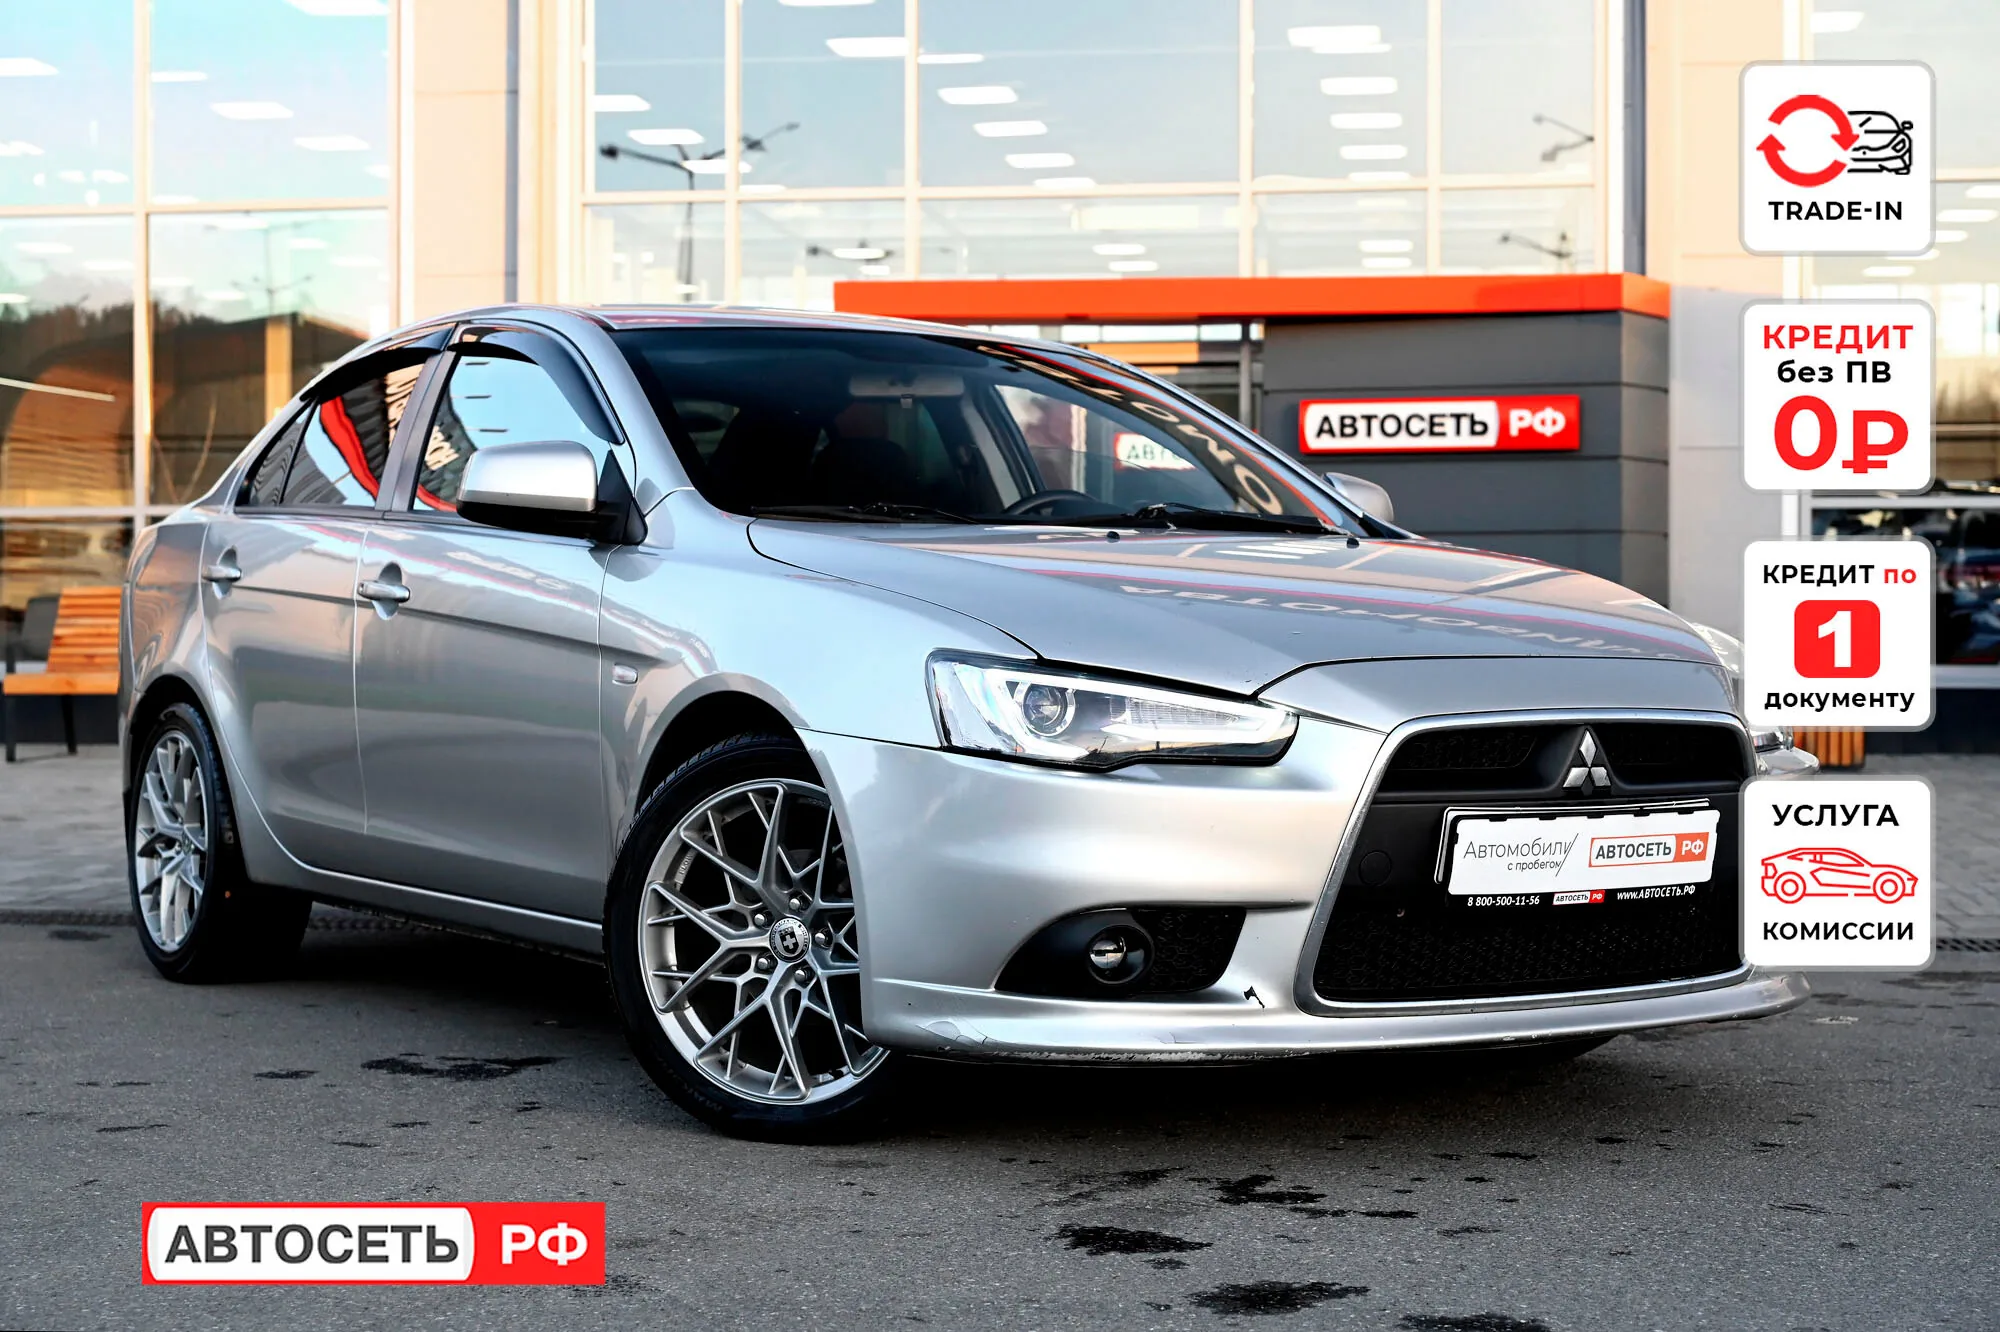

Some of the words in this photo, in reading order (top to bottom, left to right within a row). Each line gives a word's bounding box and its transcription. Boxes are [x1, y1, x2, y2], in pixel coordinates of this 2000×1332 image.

[1316, 413, 1489, 439] АВТОСЕТЬ
[1509, 407, 1566, 437] РФ
[1595, 842, 1672, 860] АВТОСЕТЬ
[1681, 839, 1704, 855] РФ
[1507, 863, 1514, 871] с
[1555, 893, 1589, 902] АВТОСЕТЬ
[1592, 892, 1603, 900] РФ
[1617, 885, 1696, 901] www.АВТОСЕТЬ.РФ
[1467, 896, 1474, 907] 8
[1475, 895, 1540, 907] 800-500-11-56
